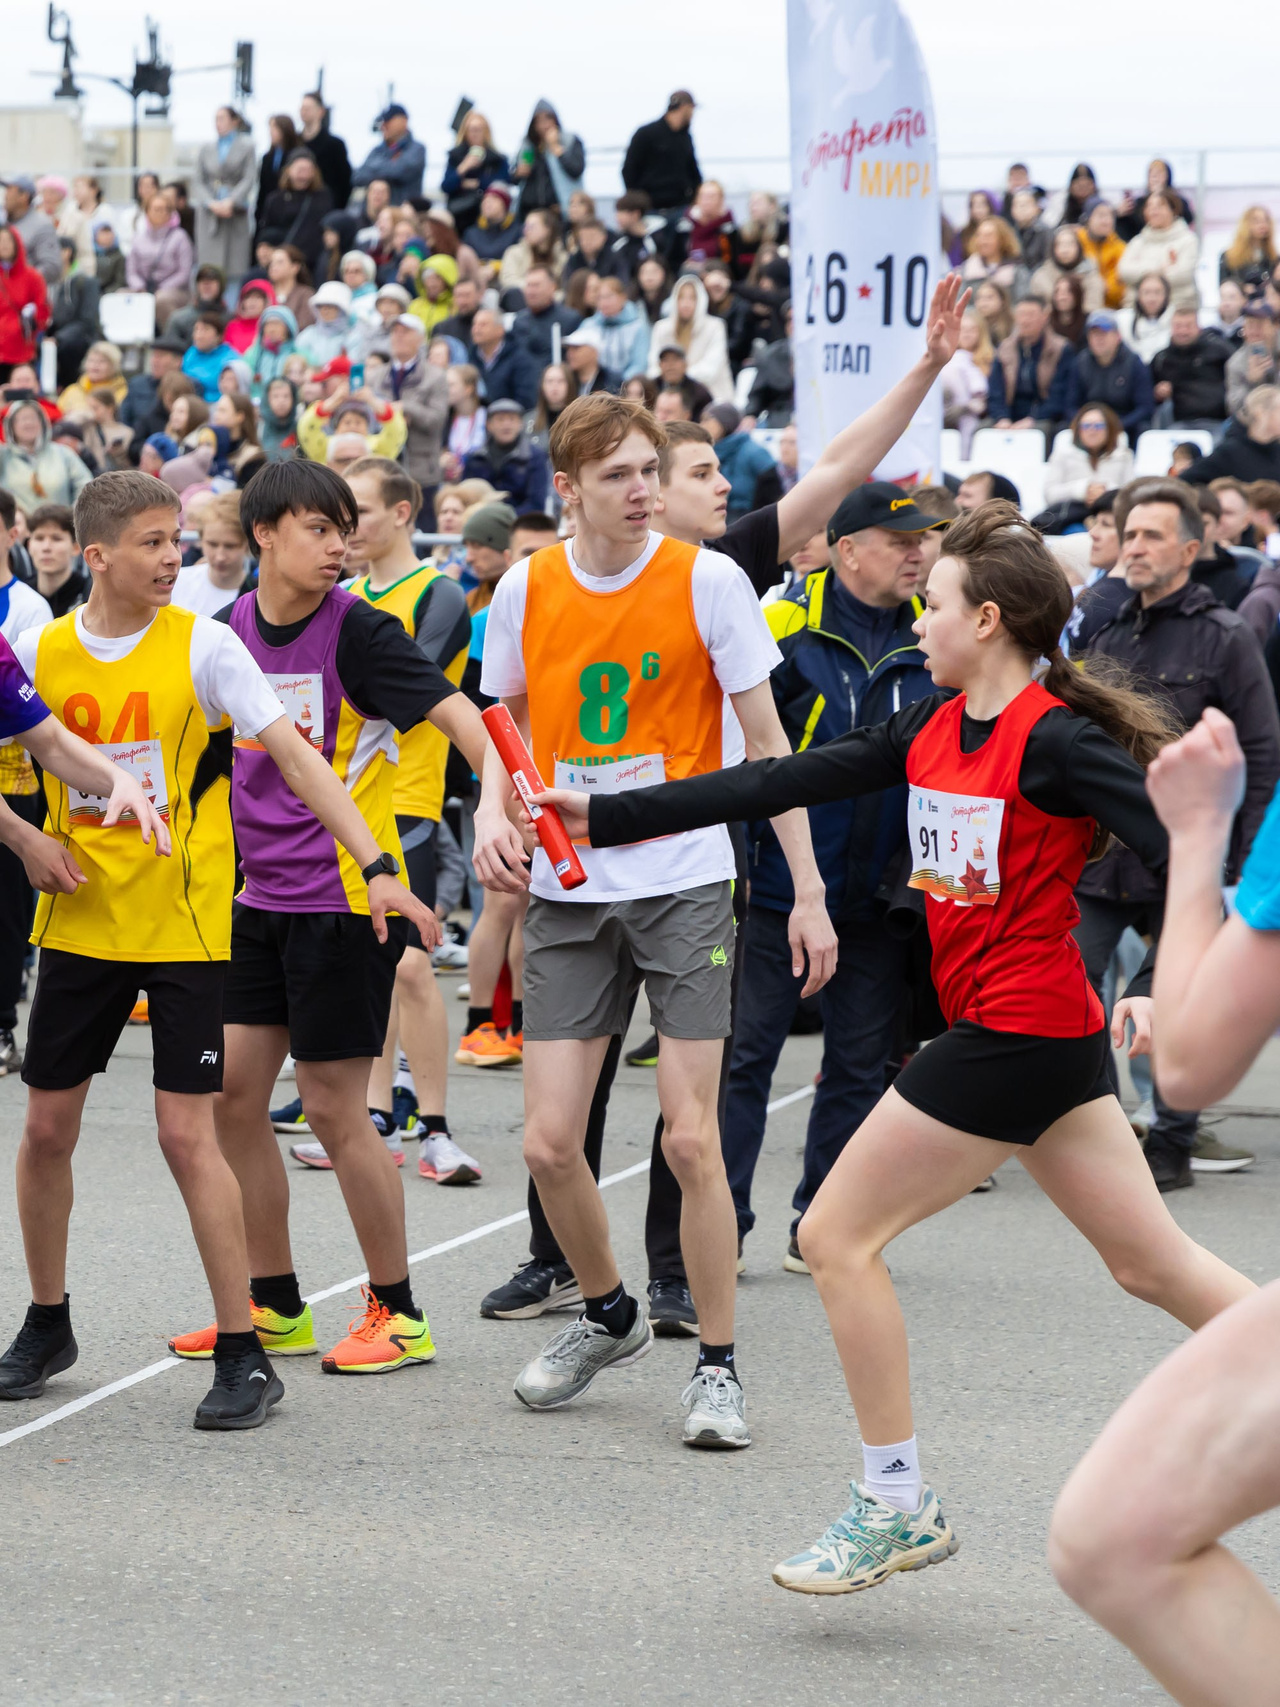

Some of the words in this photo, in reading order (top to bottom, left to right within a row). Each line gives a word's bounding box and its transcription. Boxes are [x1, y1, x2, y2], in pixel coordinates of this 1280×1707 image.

[875, 254, 928, 327] 10
[641, 651, 660, 681] 6
[63, 691, 150, 744] 84
[579, 661, 631, 746] 8
[919, 826, 939, 862] 91
[950, 830, 958, 852] 5
